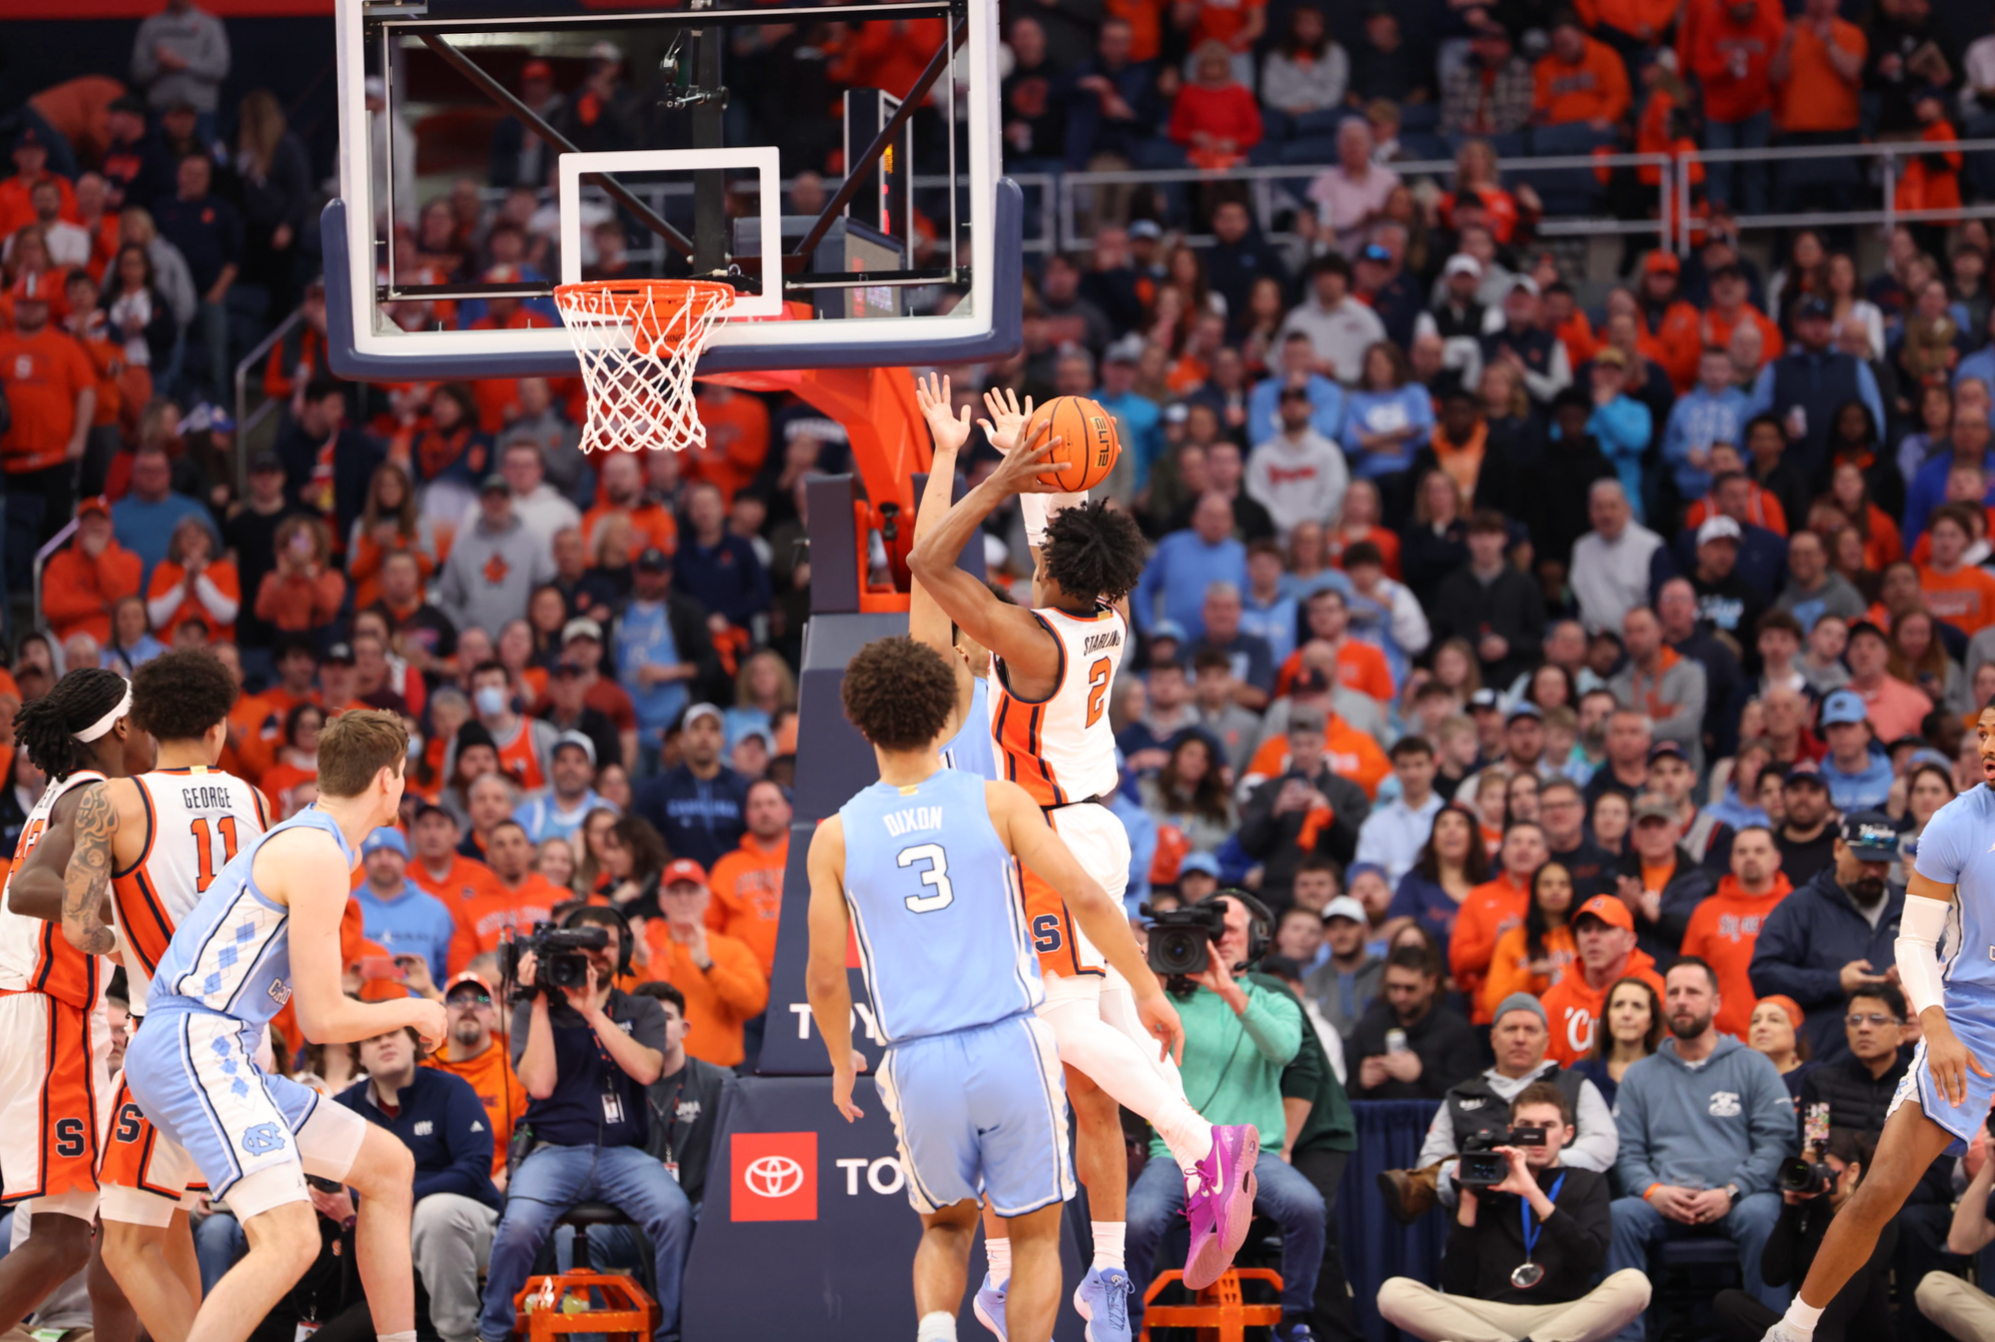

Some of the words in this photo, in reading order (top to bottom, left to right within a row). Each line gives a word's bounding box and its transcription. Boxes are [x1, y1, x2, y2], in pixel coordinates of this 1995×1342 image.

[641, 333, 686, 345] SPDING
[1094, 417, 1109, 467] ELITE
[1084, 655, 1112, 730] 2
[182, 786, 232, 809] GEORGE
[883, 806, 943, 838] DIXON
[189, 815, 239, 894] 11
[896, 842, 954, 915] 3
[1032, 914, 1062, 953] S
[789, 1002, 876, 1039] TY
[55, 1117, 86, 1158] S
[117, 1102, 145, 1143] S
